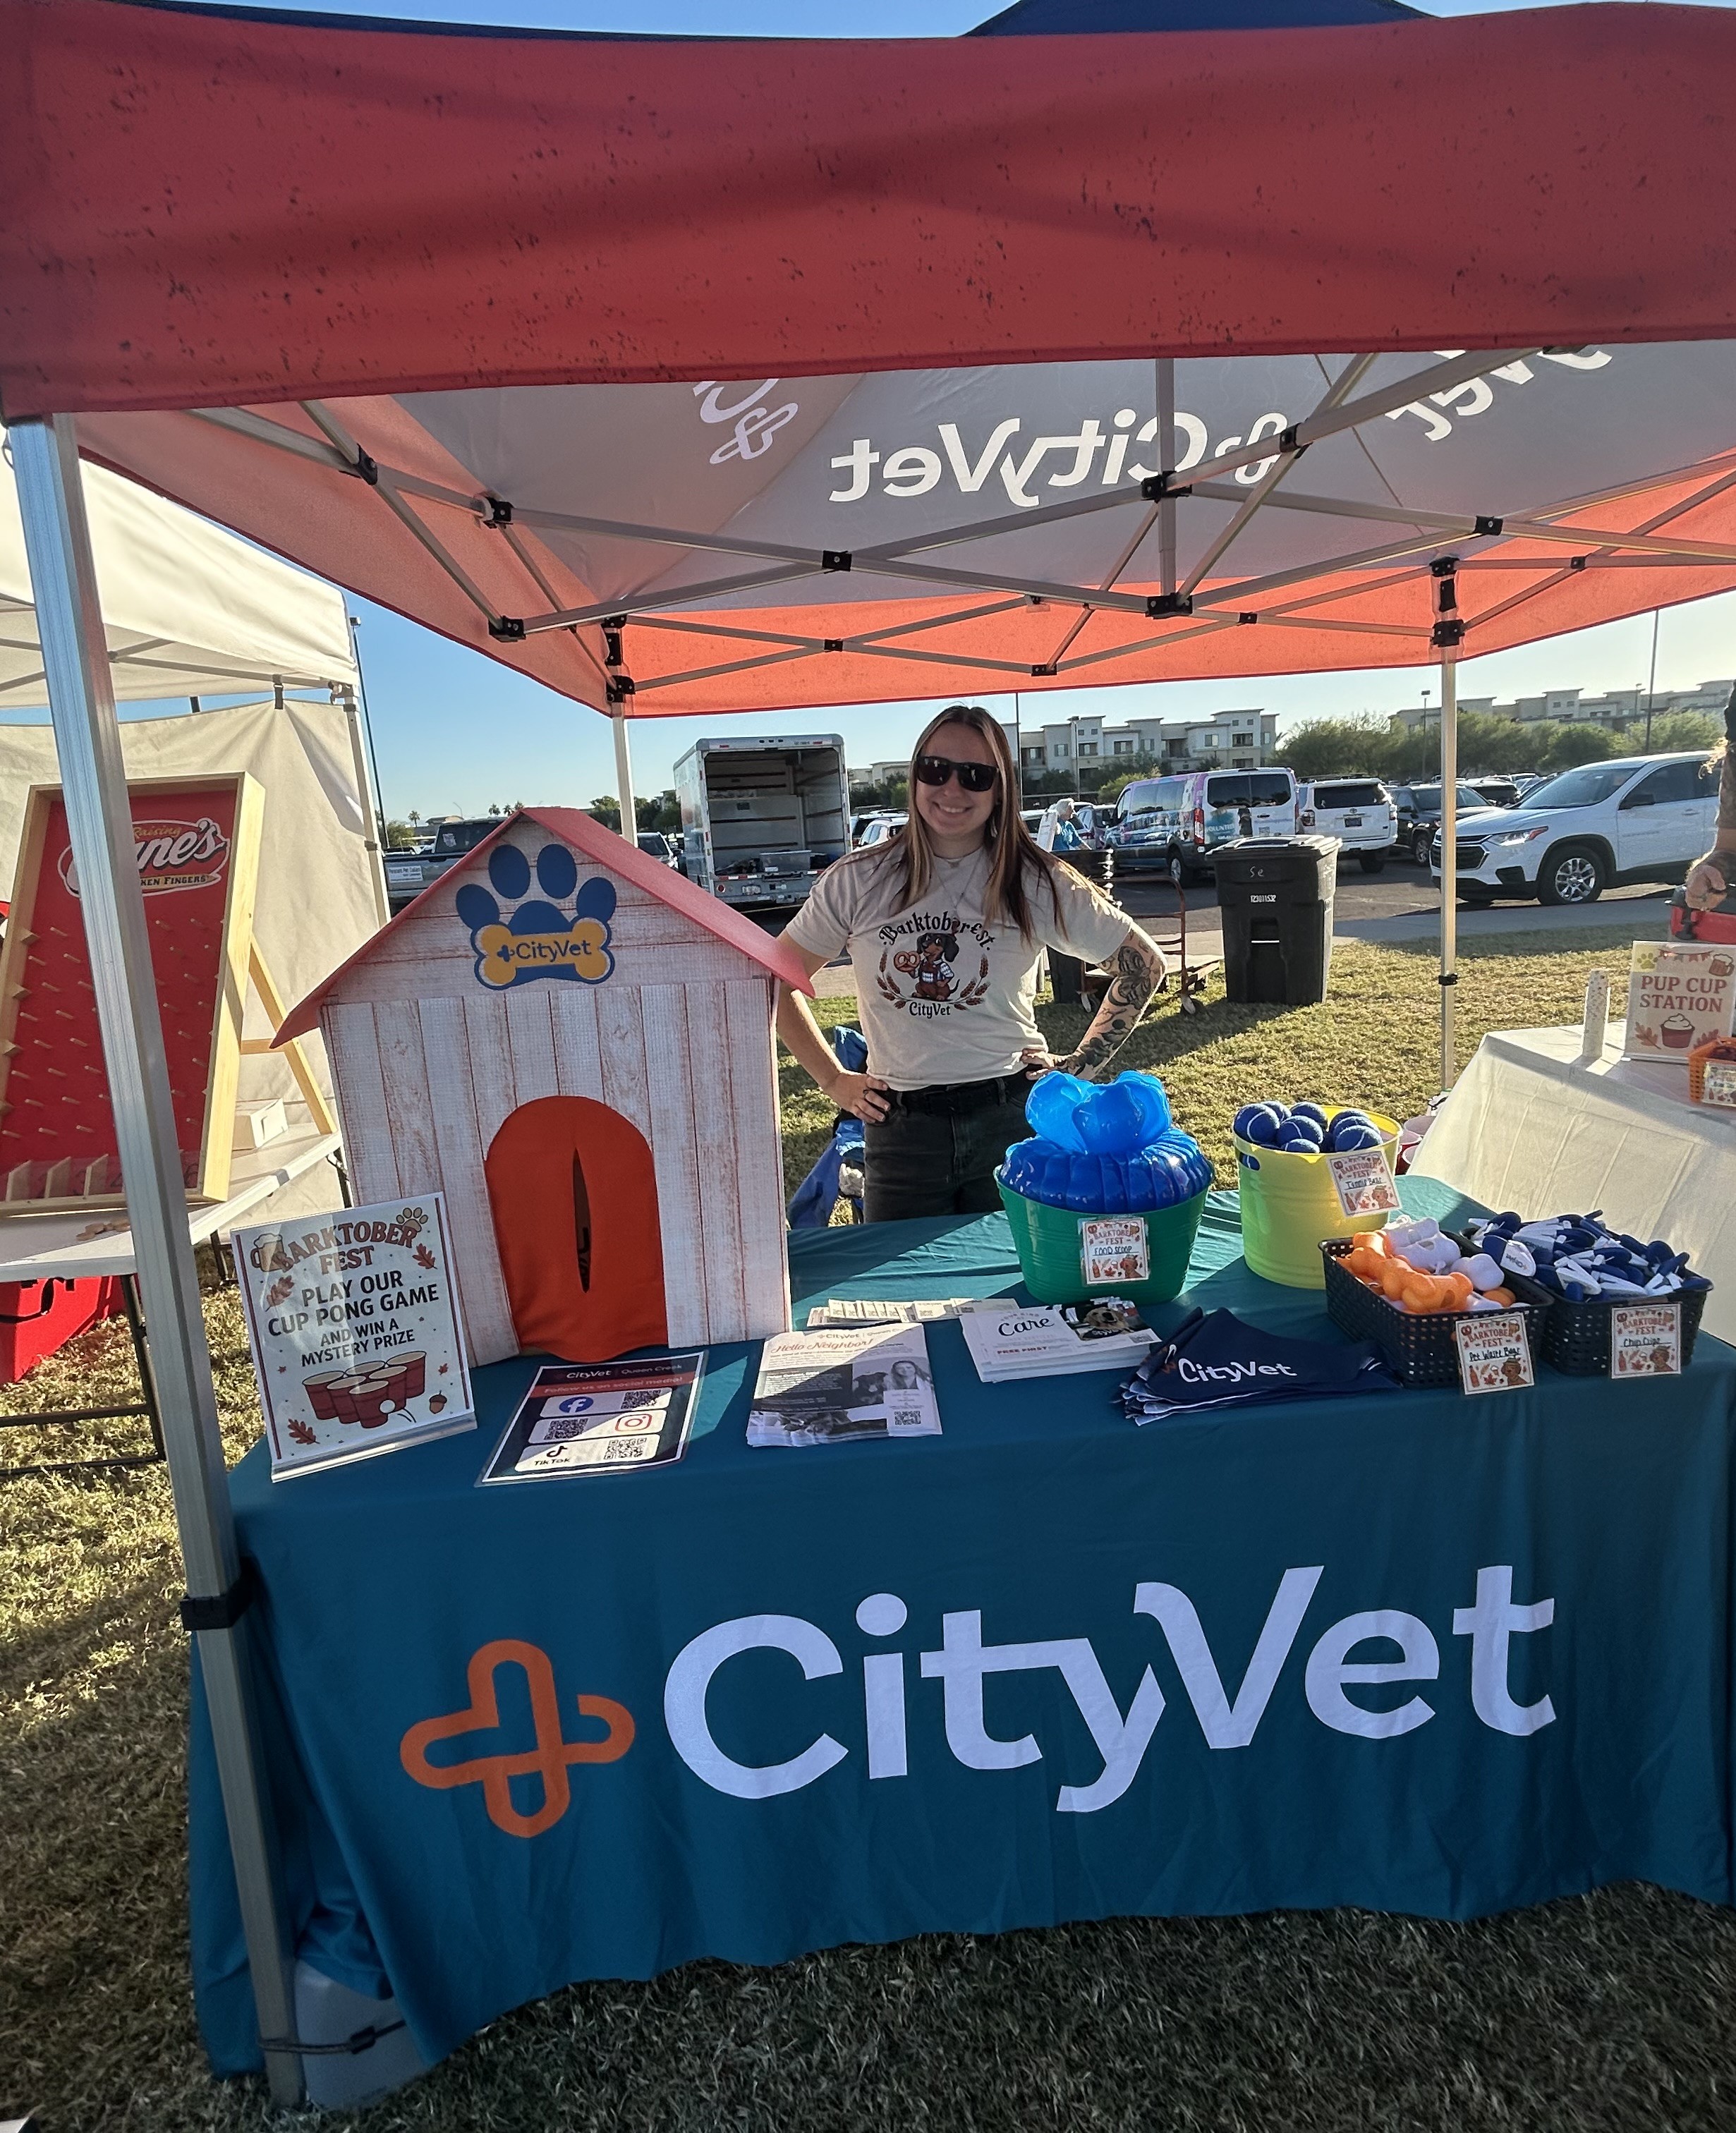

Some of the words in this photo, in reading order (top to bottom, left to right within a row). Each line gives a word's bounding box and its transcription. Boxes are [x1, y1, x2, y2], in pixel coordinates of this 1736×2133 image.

[133, 825, 183, 839] Raising
[516, 940, 592, 963] CityVet
[1641, 975, 1680, 991] PUP
[1687, 978, 1727, 994] CUP
[909, 1002, 951, 1019] CityVet
[1639, 993, 1723, 1013] STATION
[1353, 1170, 1369, 1179] FEST
[271, 1221, 419, 1272] BARKTOBER
[1095, 1246, 1112, 1255] FOOD
[320, 1245, 375, 1275] FEST
[301, 1280, 352, 1307] PLAY
[360, 1270, 403, 1294] OUR
[268, 1313, 308, 1337] CUP
[316, 1299, 374, 1326] PONG
[380, 1284, 439, 1311] GAME
[320, 1328, 351, 1347] AND
[355, 1320, 385, 1339] WIN
[389, 1318, 399, 1332] A
[998, 1318, 1055, 1336] Care
[1636, 1326, 1656, 1335] FEST
[301, 1340, 368, 1367] MYSTERY
[375, 1330, 415, 1350] PRIZE
[771, 1344, 804, 1353] Hello
[1483, 1338, 1503, 1347] FEST
[566, 1370, 612, 1378] CityVet
[1178, 1358, 1298, 1382] CityVet
[663, 1564, 1557, 1813] CityVet
